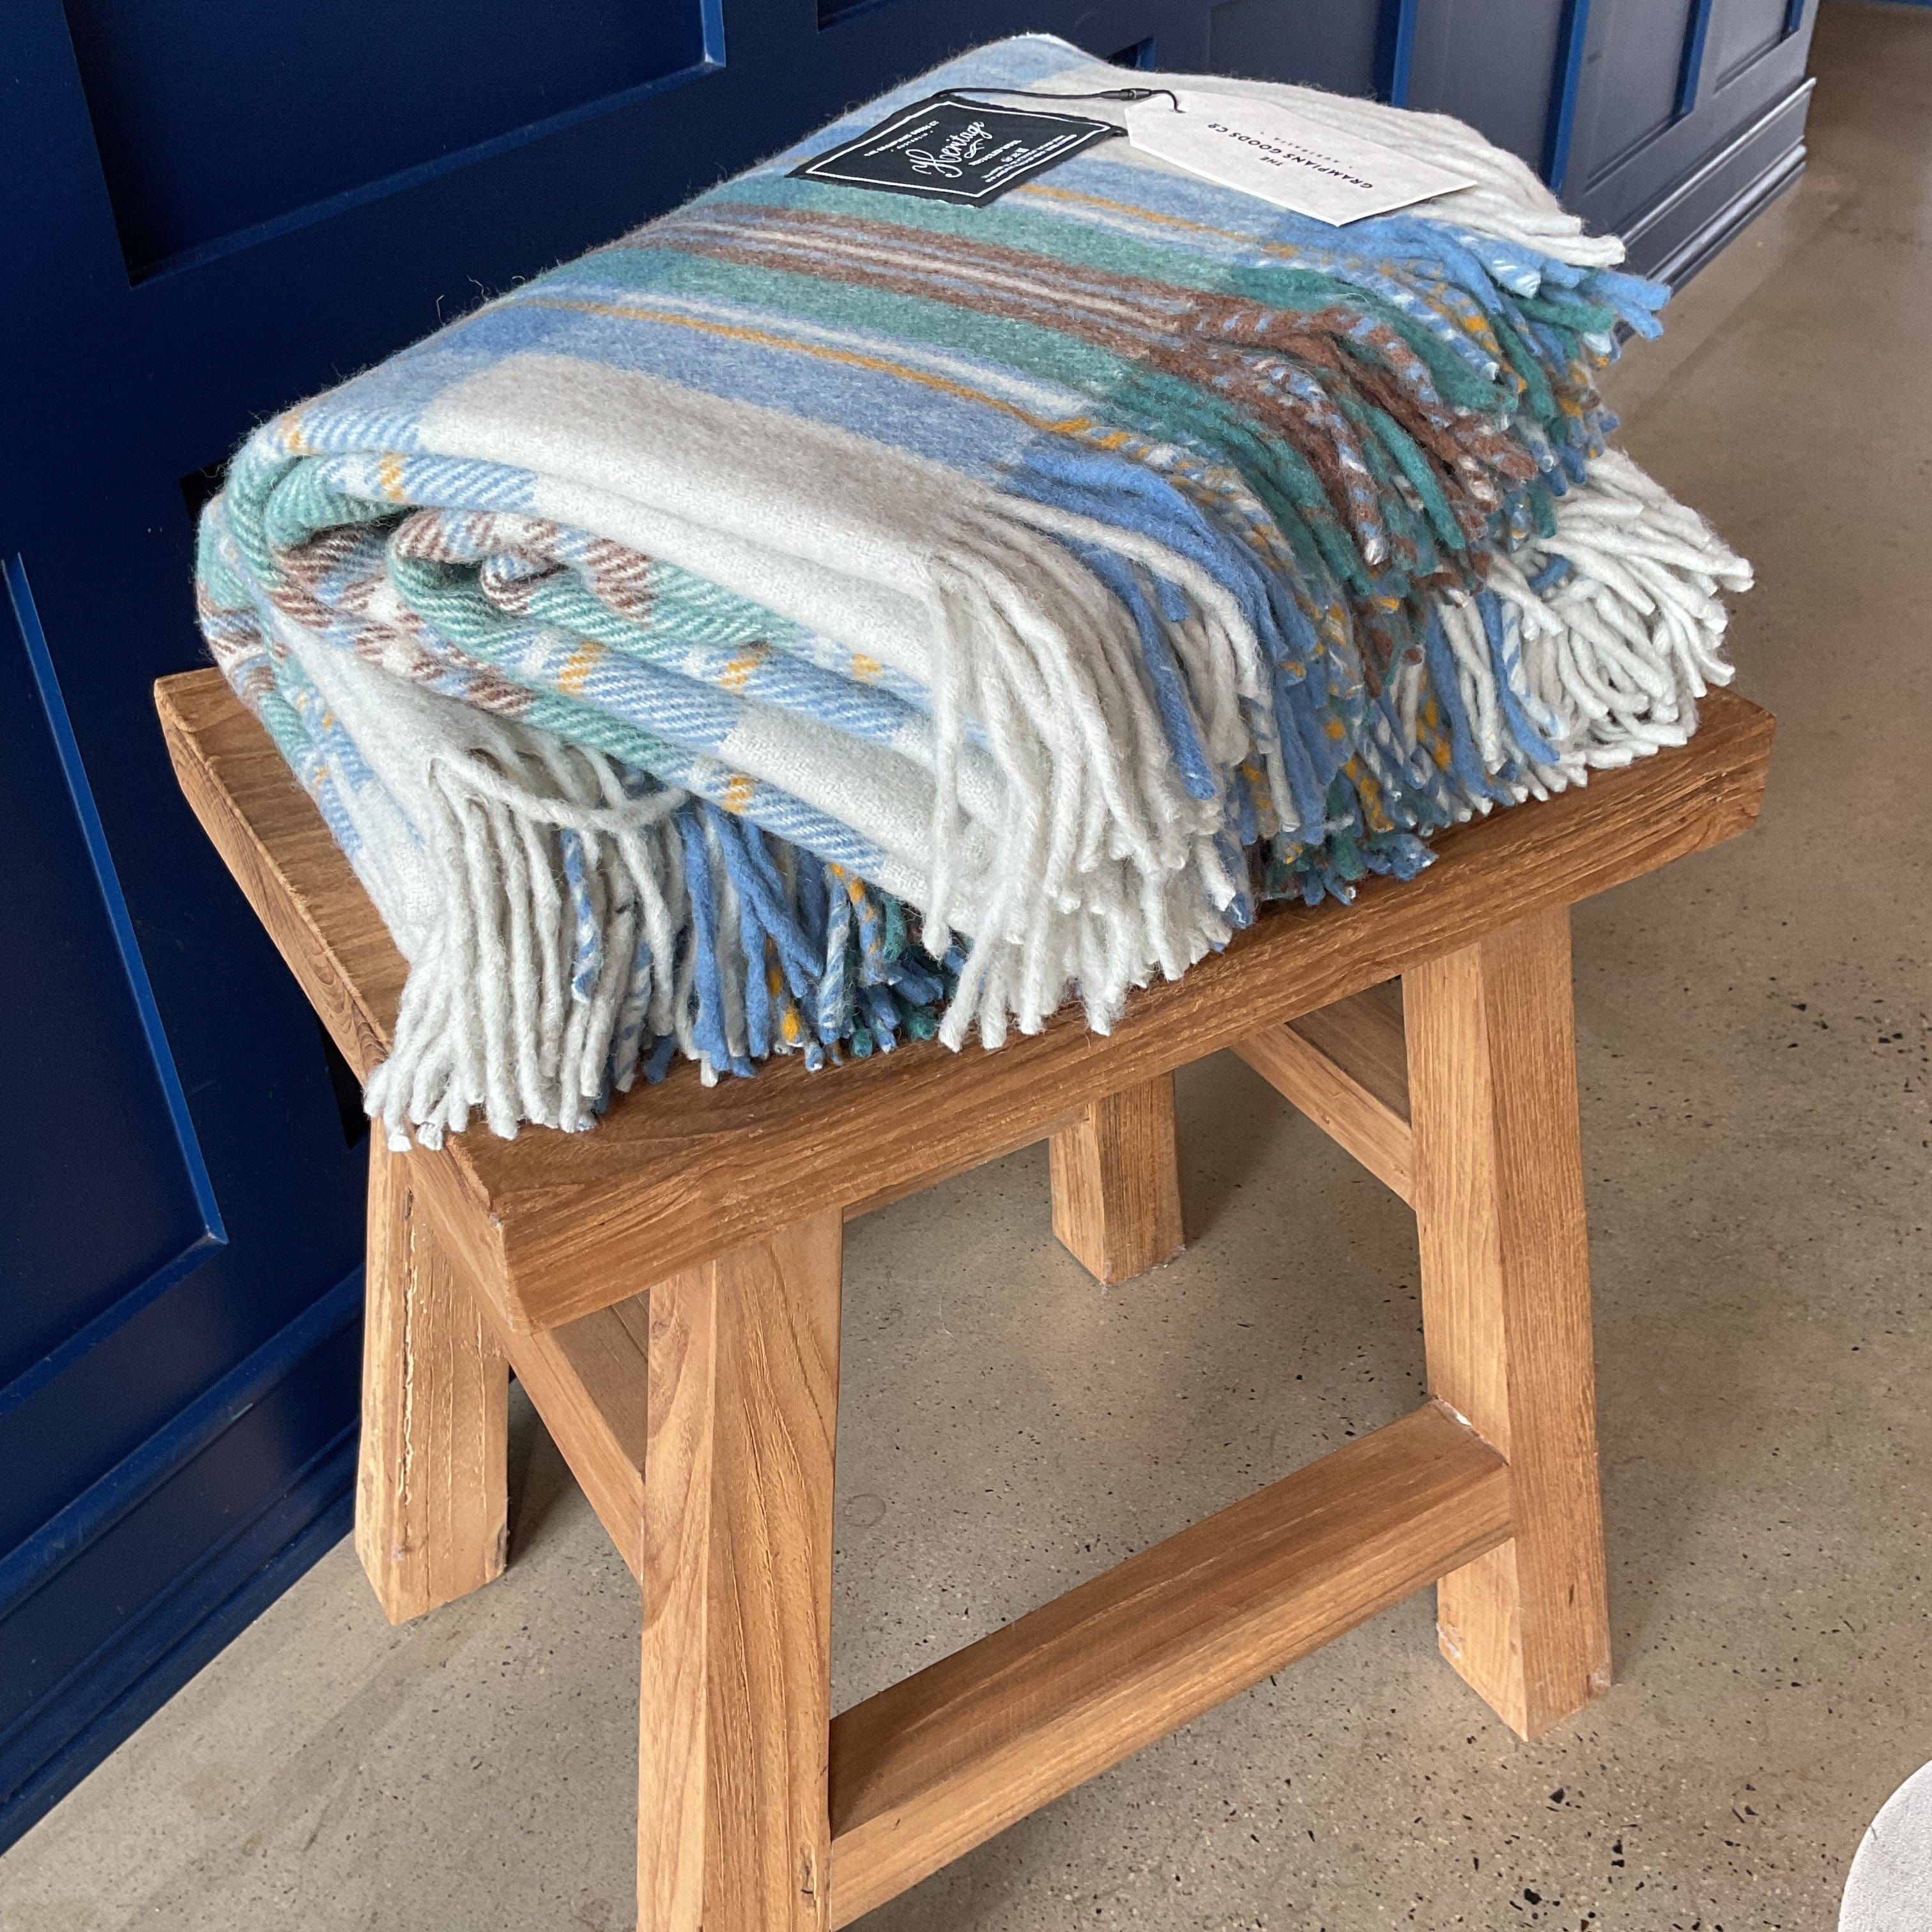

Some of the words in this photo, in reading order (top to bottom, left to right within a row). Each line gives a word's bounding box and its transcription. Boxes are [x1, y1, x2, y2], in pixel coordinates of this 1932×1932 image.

[905, 121, 993, 178] Heritage
[1229, 132, 1282, 154] GOODS
[1259, 156, 1284, 166] THE
[1282, 153, 1373, 188] GRAMPIANS
